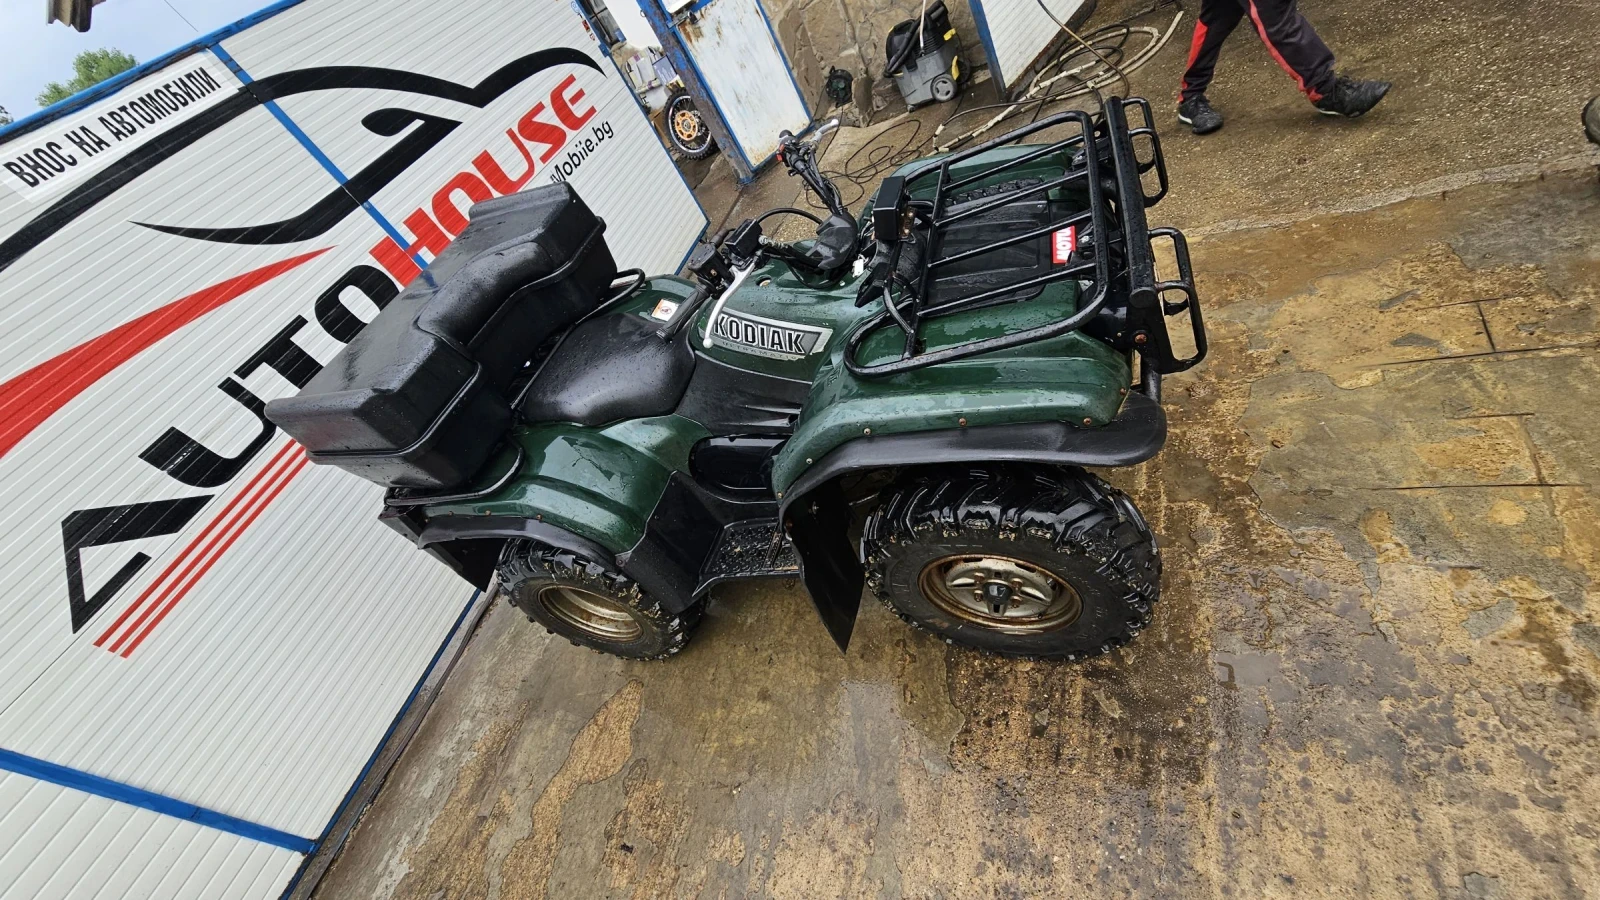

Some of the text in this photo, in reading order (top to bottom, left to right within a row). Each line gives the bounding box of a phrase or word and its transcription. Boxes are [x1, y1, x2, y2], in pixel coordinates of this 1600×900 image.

[3, 67, 222, 188] ВНОС НА АВТОМОБИЛИ
[1055, 226, 1073, 260] MOTU
[714, 313, 805, 354] KODIAK
